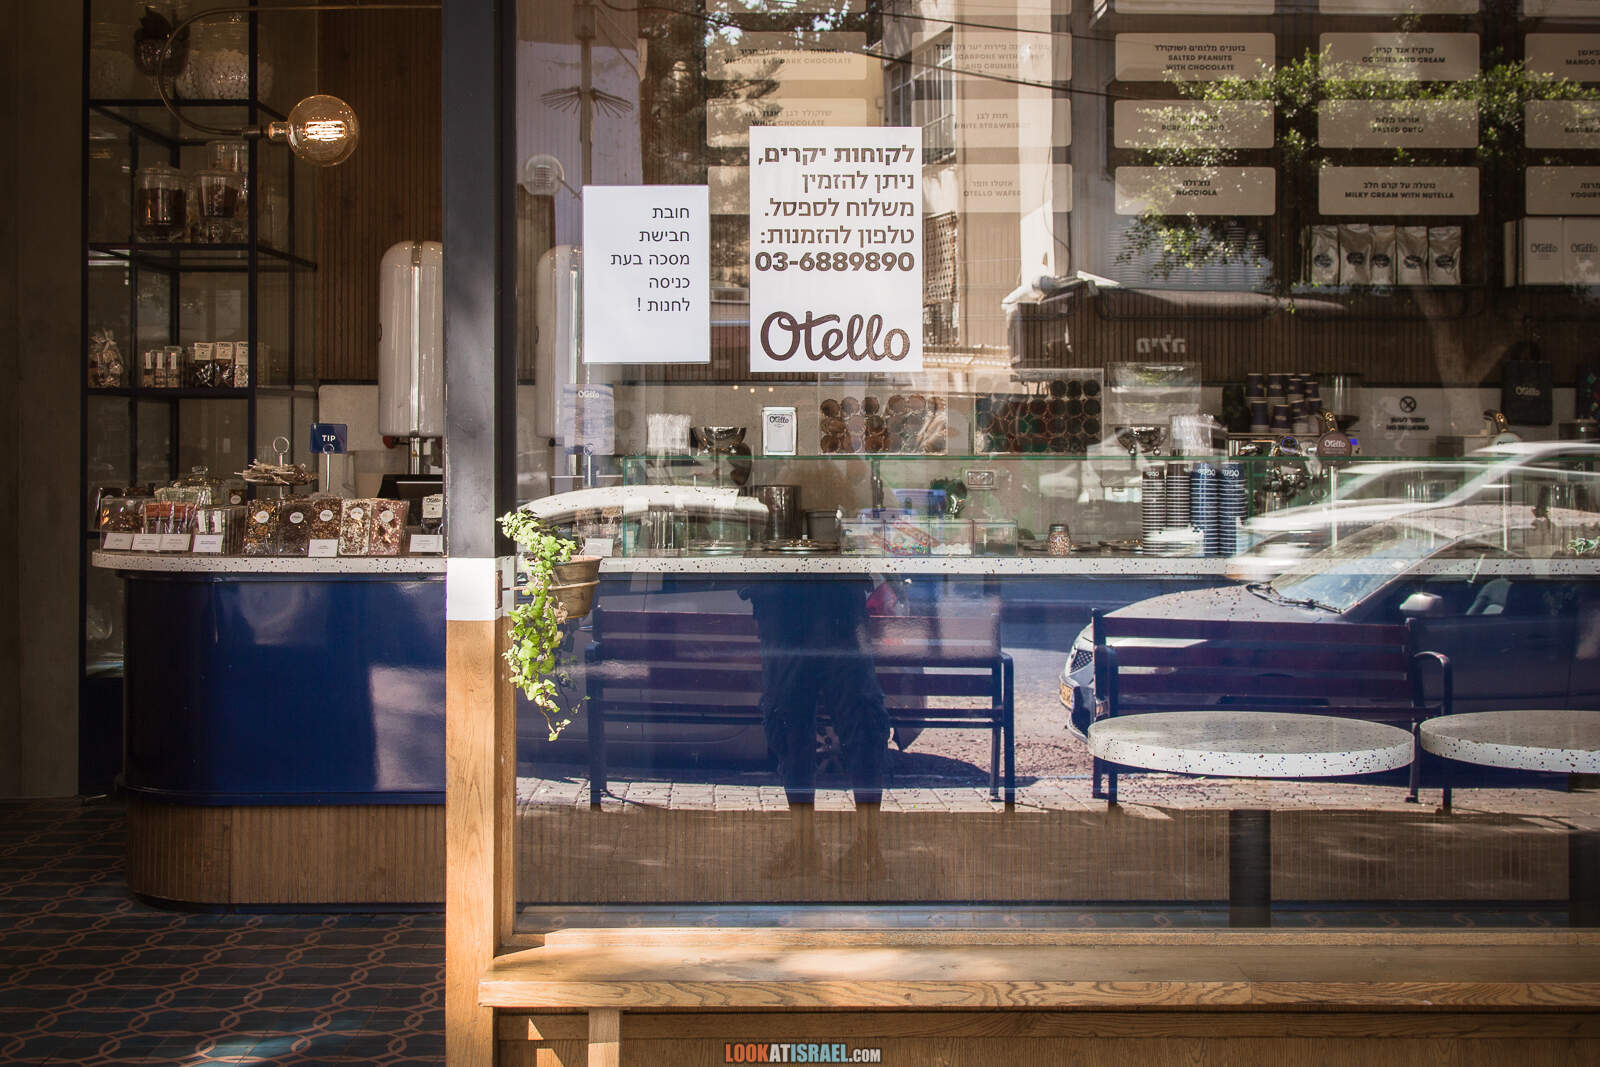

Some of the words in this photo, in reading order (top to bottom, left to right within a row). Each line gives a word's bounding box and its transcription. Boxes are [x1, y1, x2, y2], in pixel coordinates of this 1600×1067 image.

[1166, 63, 1186, 71] WITH
[1188, 63, 1235, 71] CHOCOLATE
[758, 147, 827, 166] יקרים,
[833, 144, 915, 166] לקוחות
[801, 170, 869, 193] להזמין
[874, 174, 914, 193] ניתן
[652, 207, 690, 219] חובת
[764, 197, 840, 217] לספסל.
[846, 197, 914, 217] משלוח
[639, 230, 690, 242] חבישת
[760, 225, 852, 244] להזמנות:
[857, 225, 915, 248] טלפון
[610, 254, 643, 266] בעת
[648, 254, 690, 266] מסכה
[754, 251, 915, 272] 03-6889890
[648, 277, 691, 289] כניסה
[647, 297, 691, 312] לחנות
[760, 310, 911, 362] Otello
[321, 434, 336, 442] TIP
